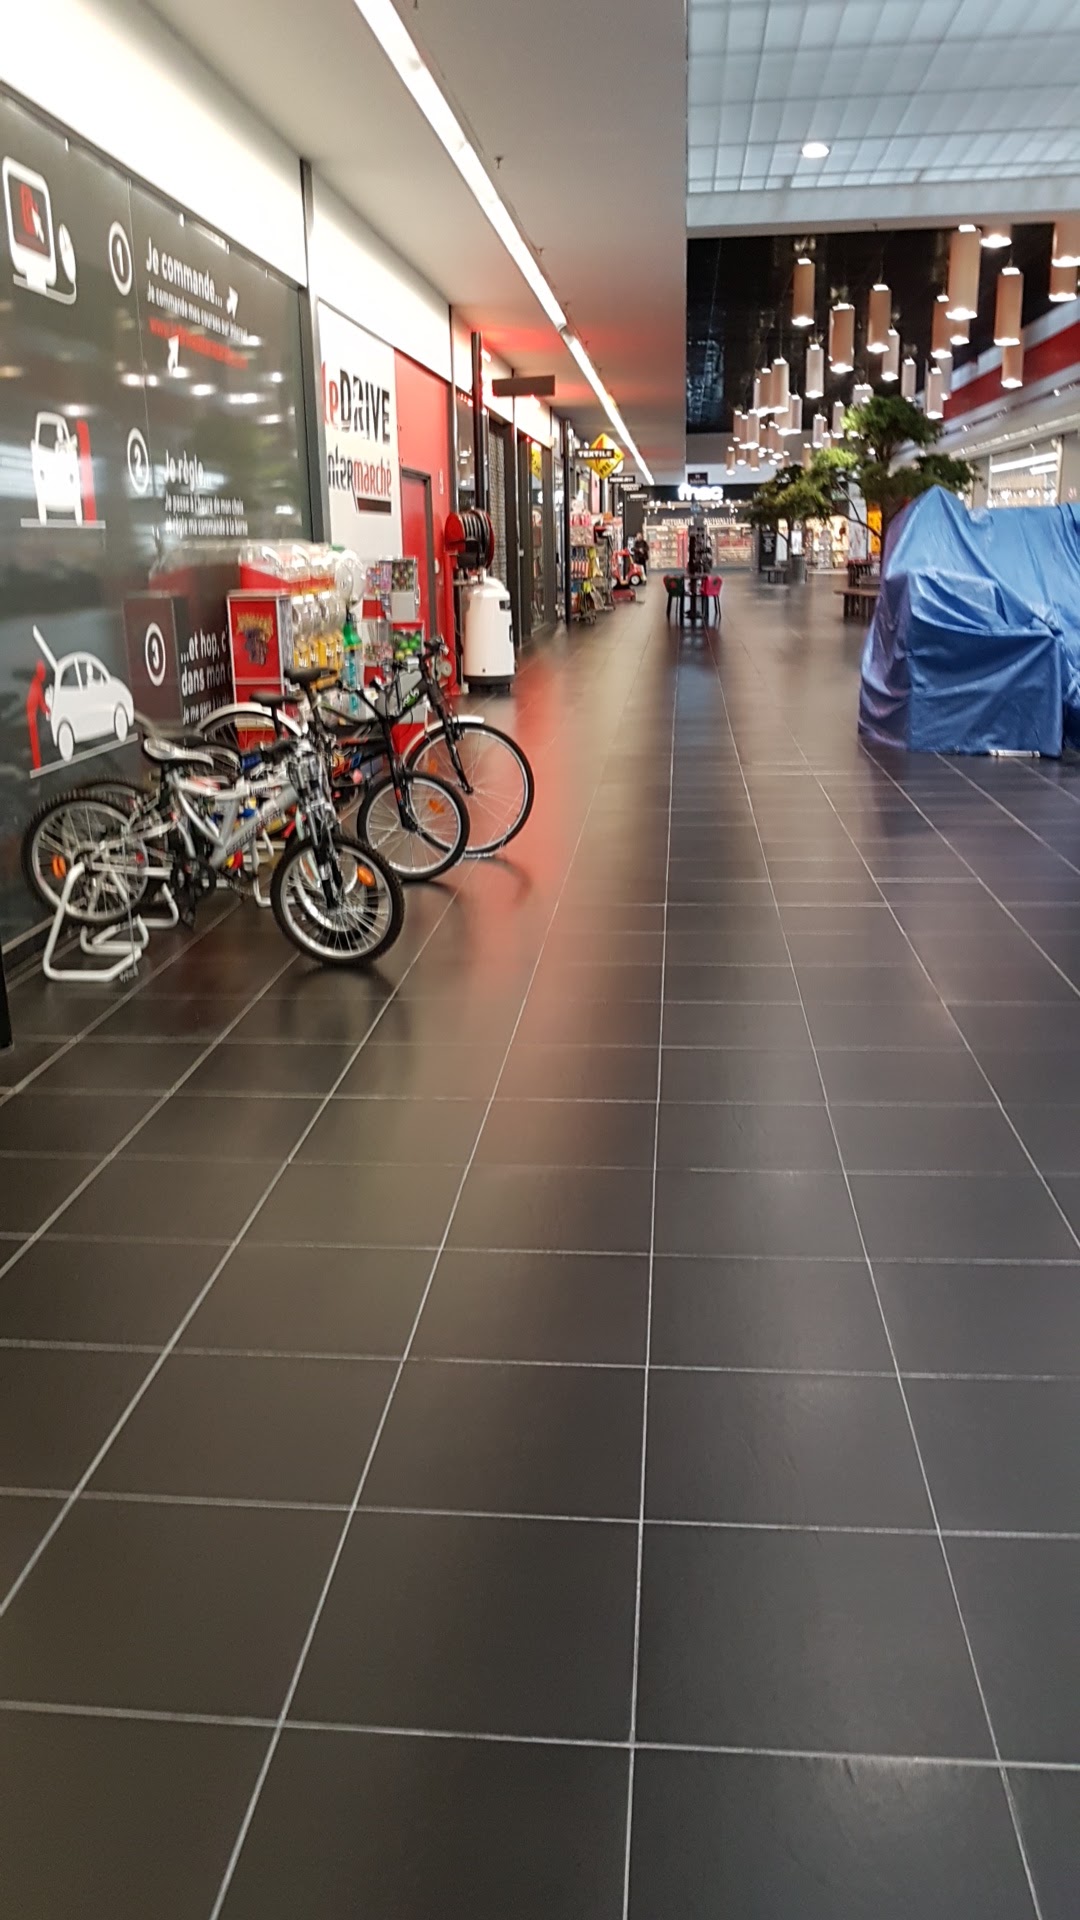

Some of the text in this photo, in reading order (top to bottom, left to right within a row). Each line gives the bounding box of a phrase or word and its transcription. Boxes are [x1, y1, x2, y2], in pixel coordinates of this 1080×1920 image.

[117, 239, 124, 277] 1
[146, 236, 159, 276] Je
[134, 443, 143, 478] 2
[164, 449, 176, 484] Je
[577, 450, 612, 458] TEXTILE
[151, 638, 160, 669] 3
[200, 628, 220, 662] hop,
[181, 666, 205, 697] dans
[206, 662, 226, 690] mon
